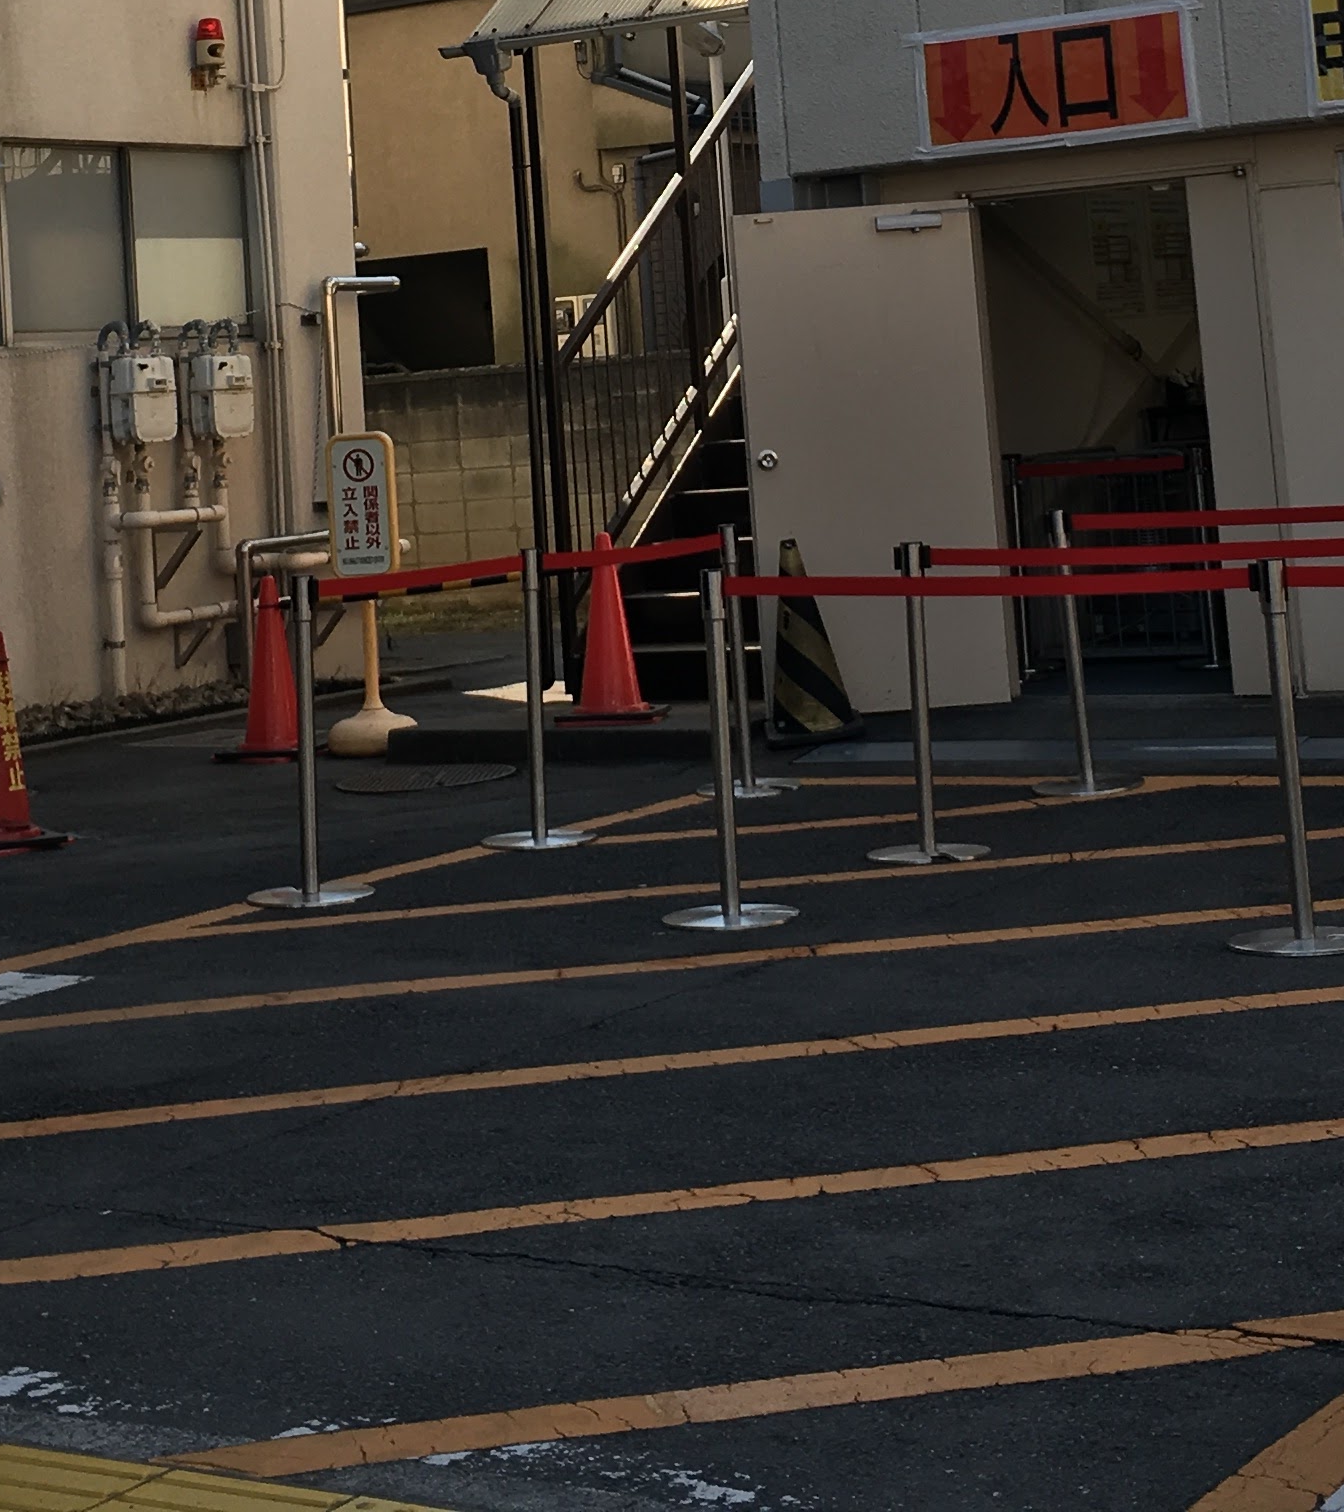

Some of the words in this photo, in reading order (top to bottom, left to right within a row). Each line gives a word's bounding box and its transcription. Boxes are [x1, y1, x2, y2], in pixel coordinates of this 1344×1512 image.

[990, 24, 1118, 135] 入口
[342, 487, 360, 550] 立入禁止
[363, 485, 381, 549] 関係者以外
